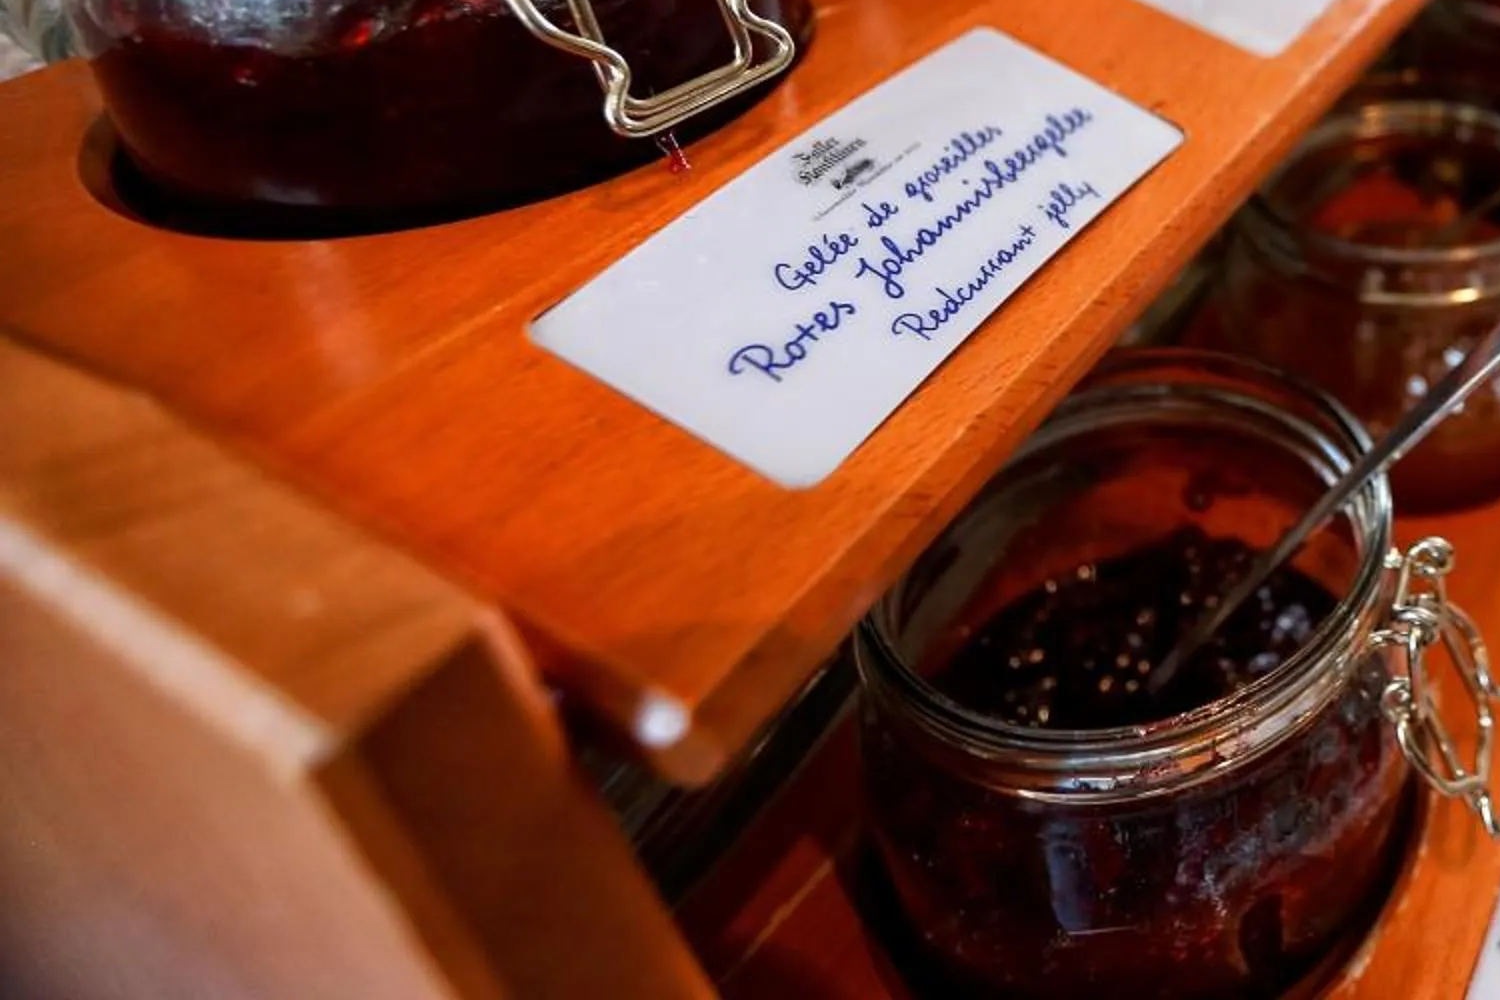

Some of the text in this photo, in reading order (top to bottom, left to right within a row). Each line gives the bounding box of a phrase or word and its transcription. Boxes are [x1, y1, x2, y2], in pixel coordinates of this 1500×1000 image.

[774, 232, 859, 291] Gelée
[861, 201, 899, 229] de
[891, 181, 1101, 342] Redcurrant jelly
[728, 300, 856, 384] Rotes
